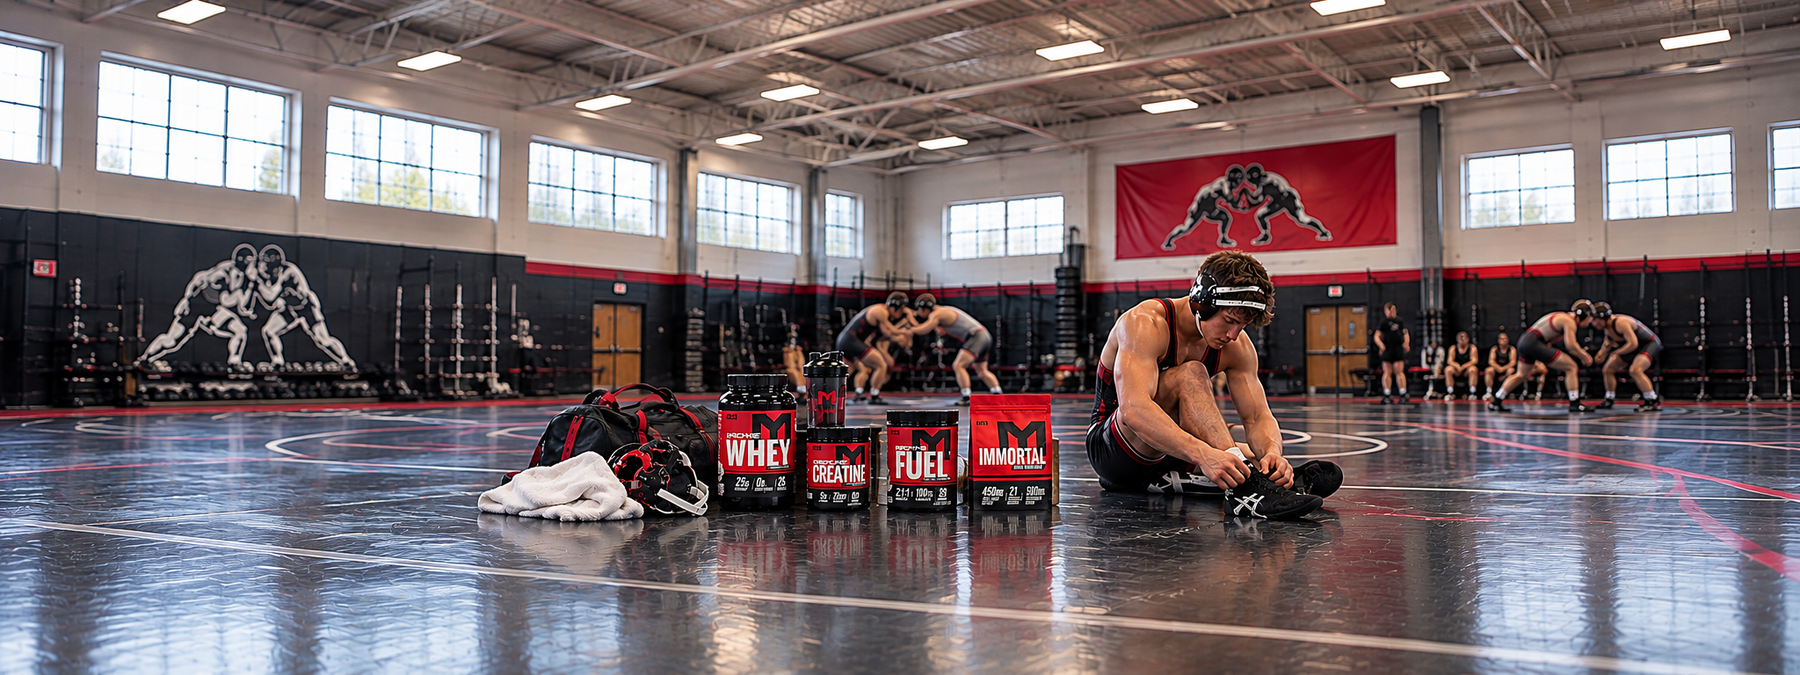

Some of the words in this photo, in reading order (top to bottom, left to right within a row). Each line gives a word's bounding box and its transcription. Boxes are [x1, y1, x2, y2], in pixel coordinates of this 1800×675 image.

[726, 439, 790, 467] WHEY
[979, 447, 1046, 466] IMMORTAL
[813, 464, 866, 483] CREATINE
[895, 450, 948, 480] FUEL
